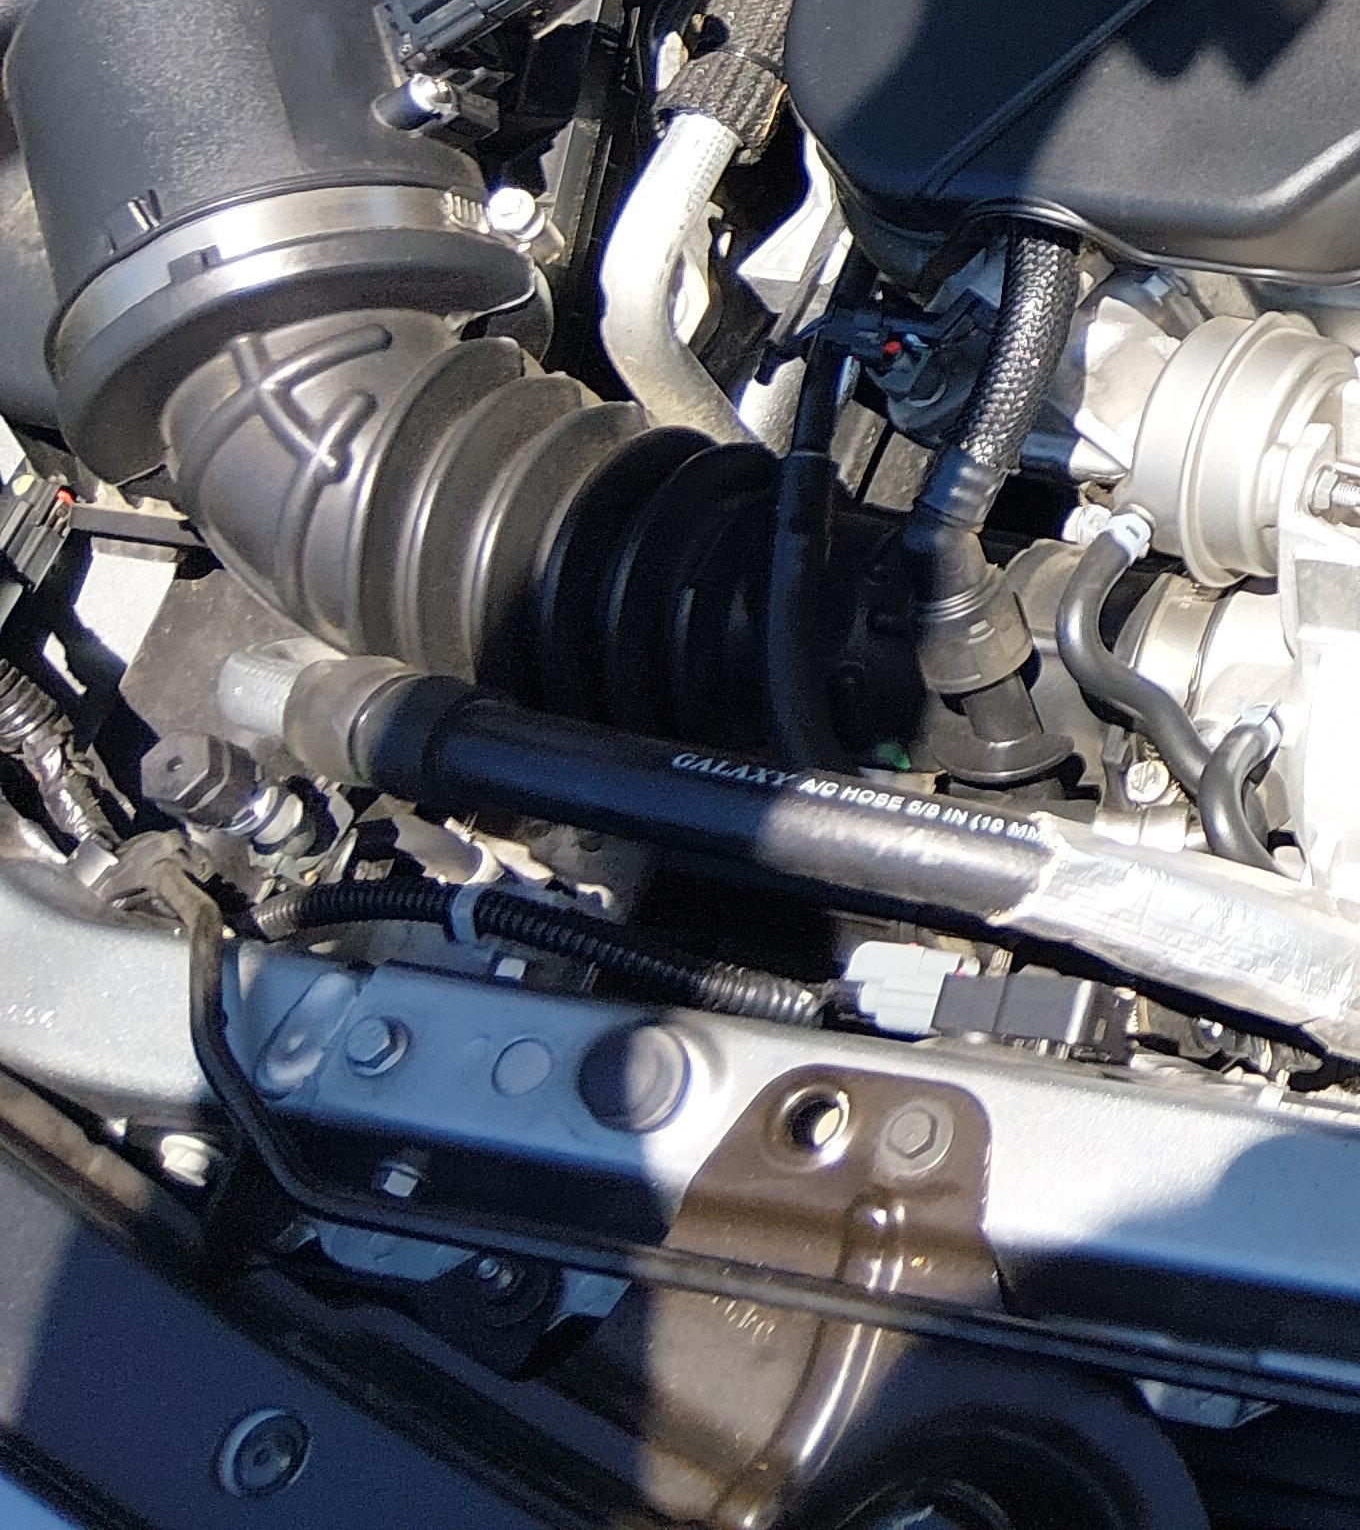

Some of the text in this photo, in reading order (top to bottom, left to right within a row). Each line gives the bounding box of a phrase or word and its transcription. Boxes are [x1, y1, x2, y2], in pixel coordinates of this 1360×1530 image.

[670, 753, 799, 788] GALAXY
[797, 777, 840, 798] A/C
[839, 785, 906, 812] HOSE
[941, 806, 969, 827] IN
